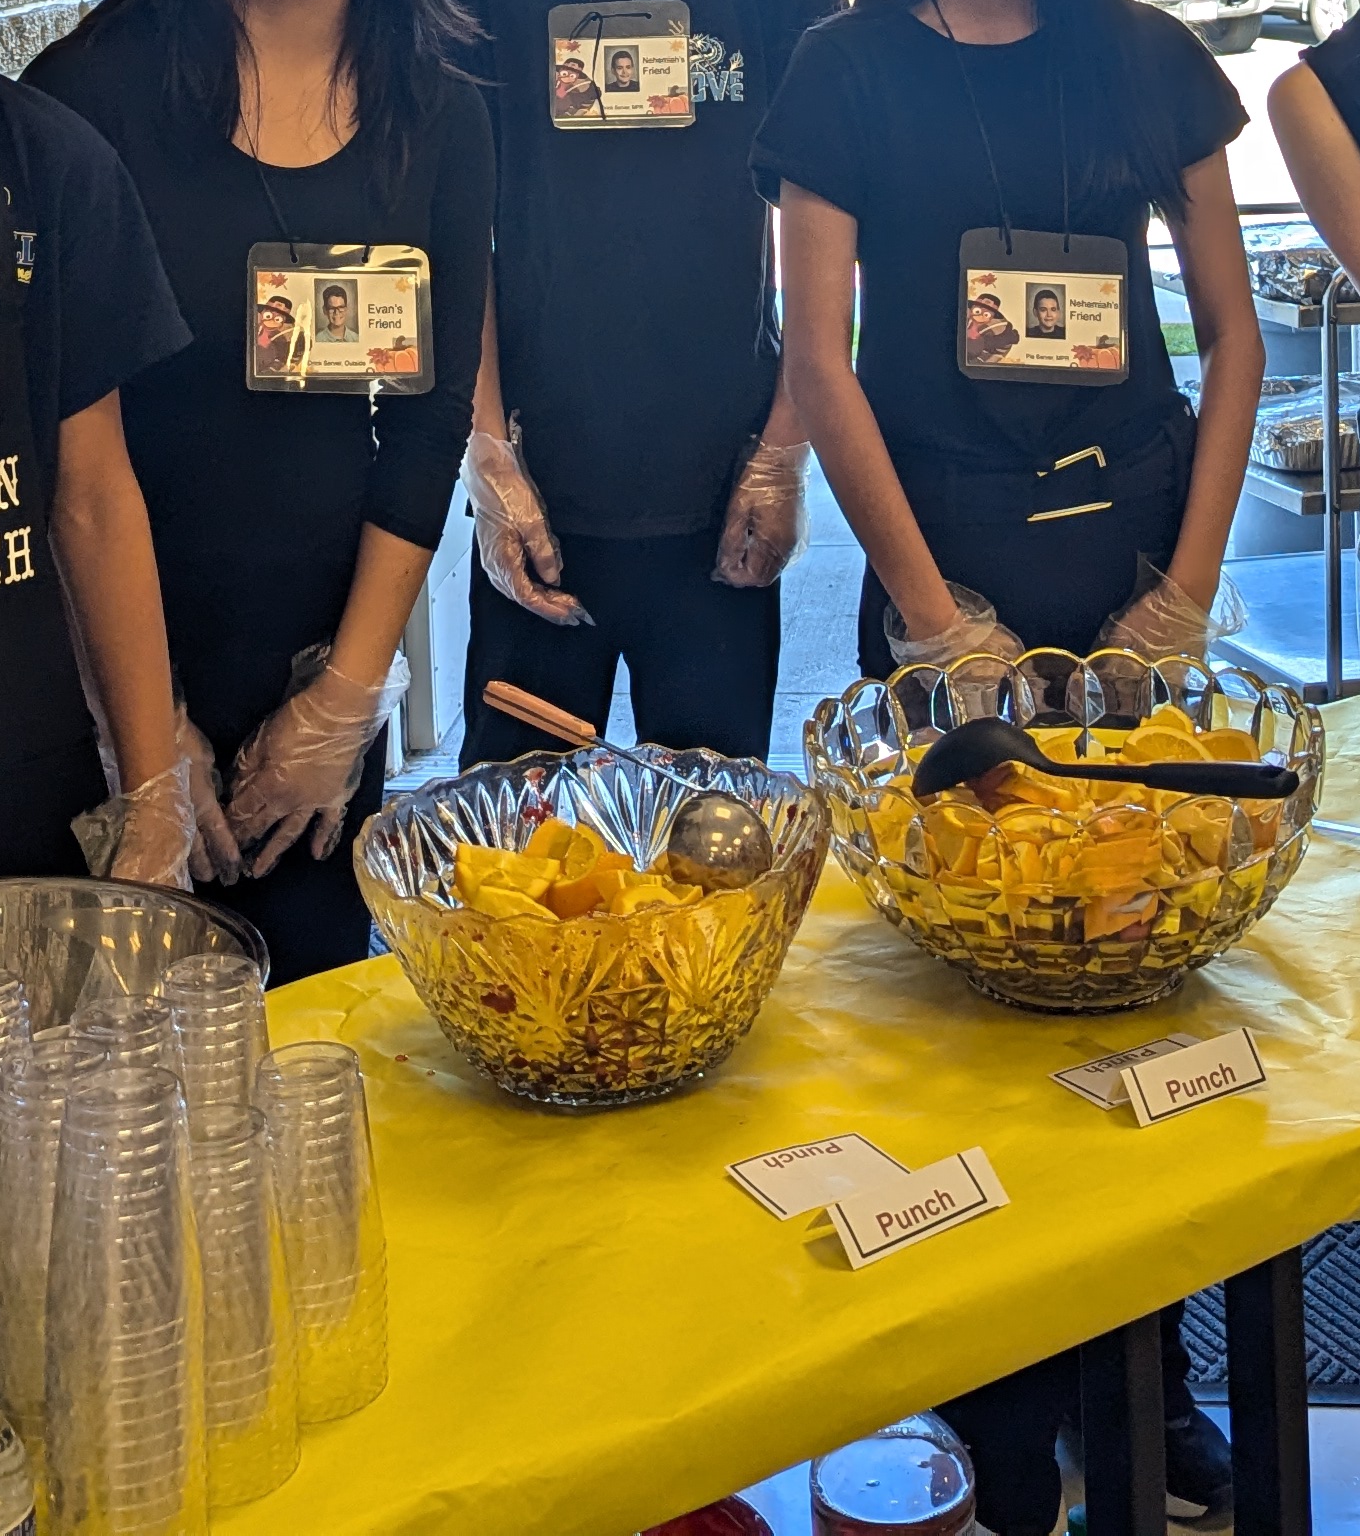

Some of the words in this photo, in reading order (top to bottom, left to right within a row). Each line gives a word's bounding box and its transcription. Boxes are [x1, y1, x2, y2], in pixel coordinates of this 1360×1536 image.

[642, 56, 685, 64] Nehemiah's
[690, 70, 744, 102] OVE
[367, 303, 403, 314] Evan's
[1069, 299, 1119, 309] Nehemiah's
[368, 318, 402, 329] Friend
[1069, 311, 1102, 321] Friend
[1083, 1048, 1158, 1073] Punch
[1165, 1063, 1237, 1104] Punch
[762, 1142, 844, 1169] Punch
[875, 1189, 956, 1238] Punch
